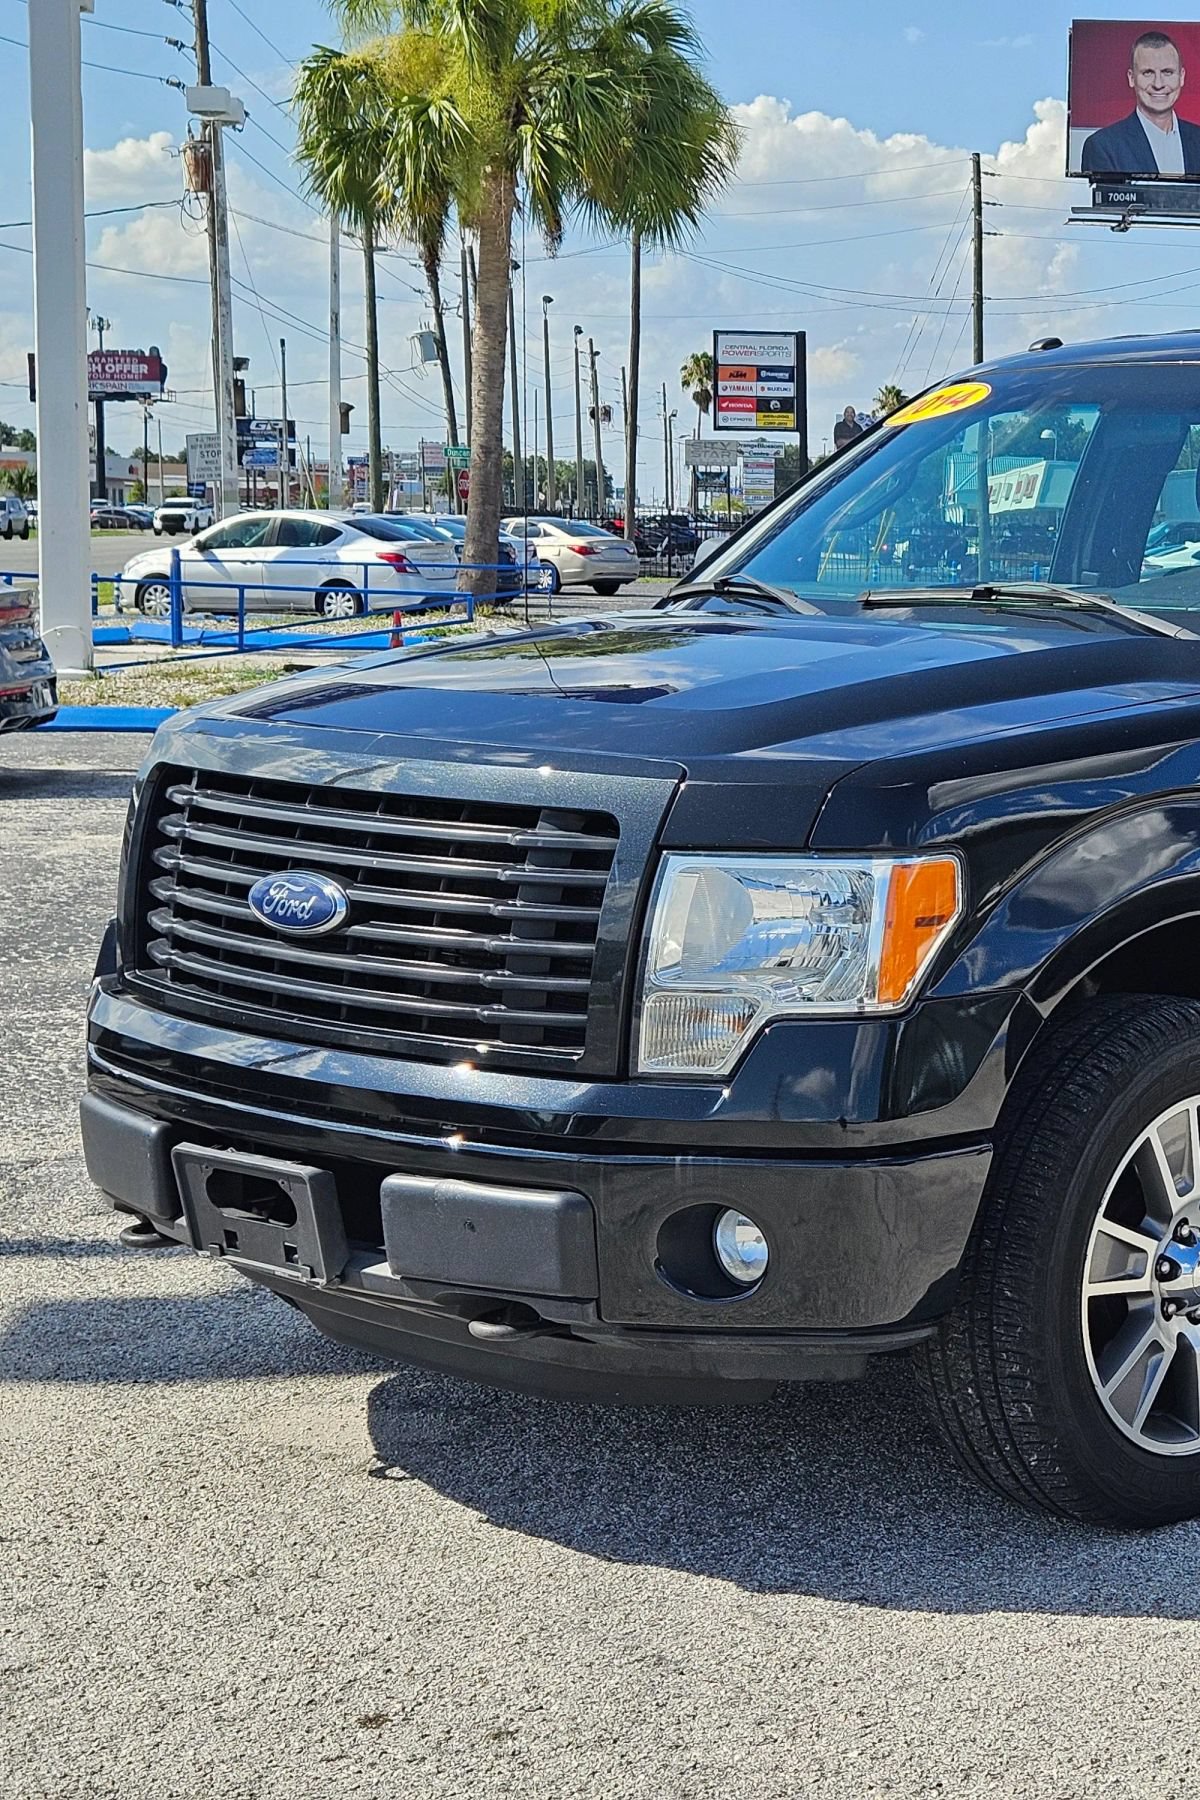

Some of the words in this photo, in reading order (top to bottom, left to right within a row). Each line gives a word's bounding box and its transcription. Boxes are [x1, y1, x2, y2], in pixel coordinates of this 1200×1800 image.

[1107, 192, 1137, 202] 7004N
[722, 350, 792, 358] POWERSPORTS
[104, 363, 149, 375] OFFER
[728, 371, 747, 379] KTM
[729, 384, 754, 393] YAMAHA
[200, 450, 222, 458] STOP
[691, 450, 730, 458] STAR
[262, 881, 318, 920] Ford
